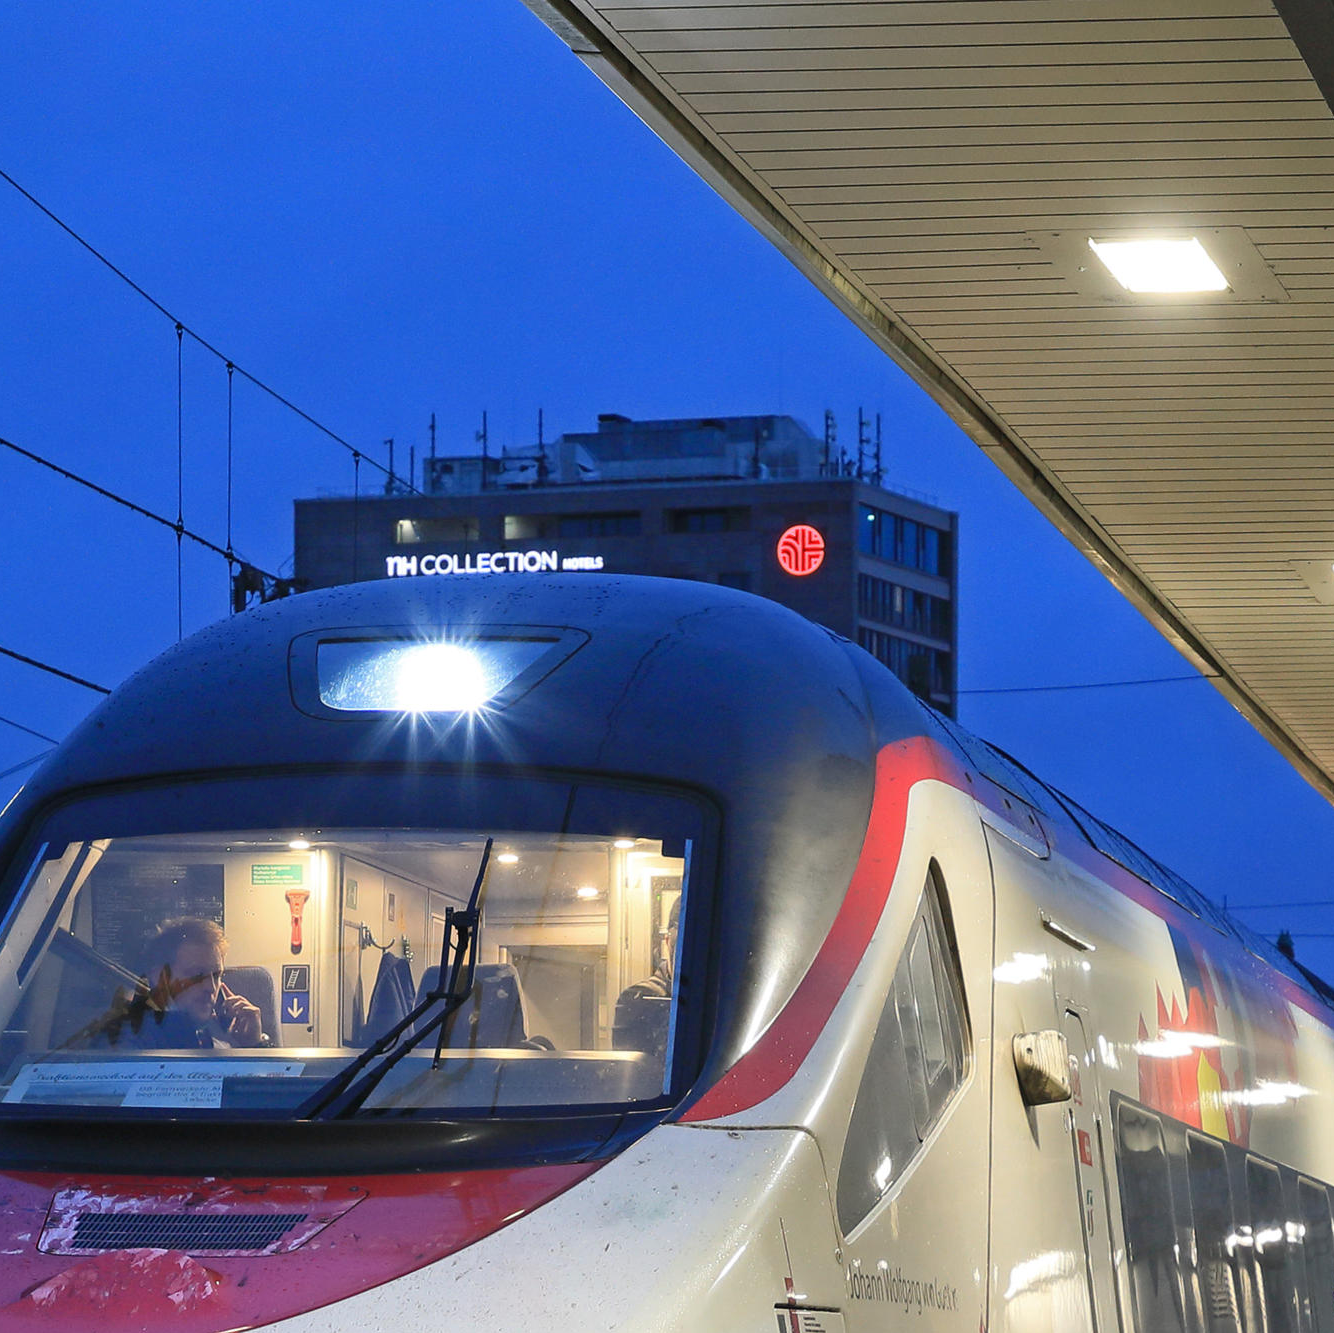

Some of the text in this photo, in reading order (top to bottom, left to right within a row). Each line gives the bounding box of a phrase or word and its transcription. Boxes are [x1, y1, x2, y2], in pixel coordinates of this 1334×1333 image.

[420, 550, 558, 575] COLLECTION
[562, 556, 605, 571] HOTELS
[848, 1264, 884, 1300] Johann
